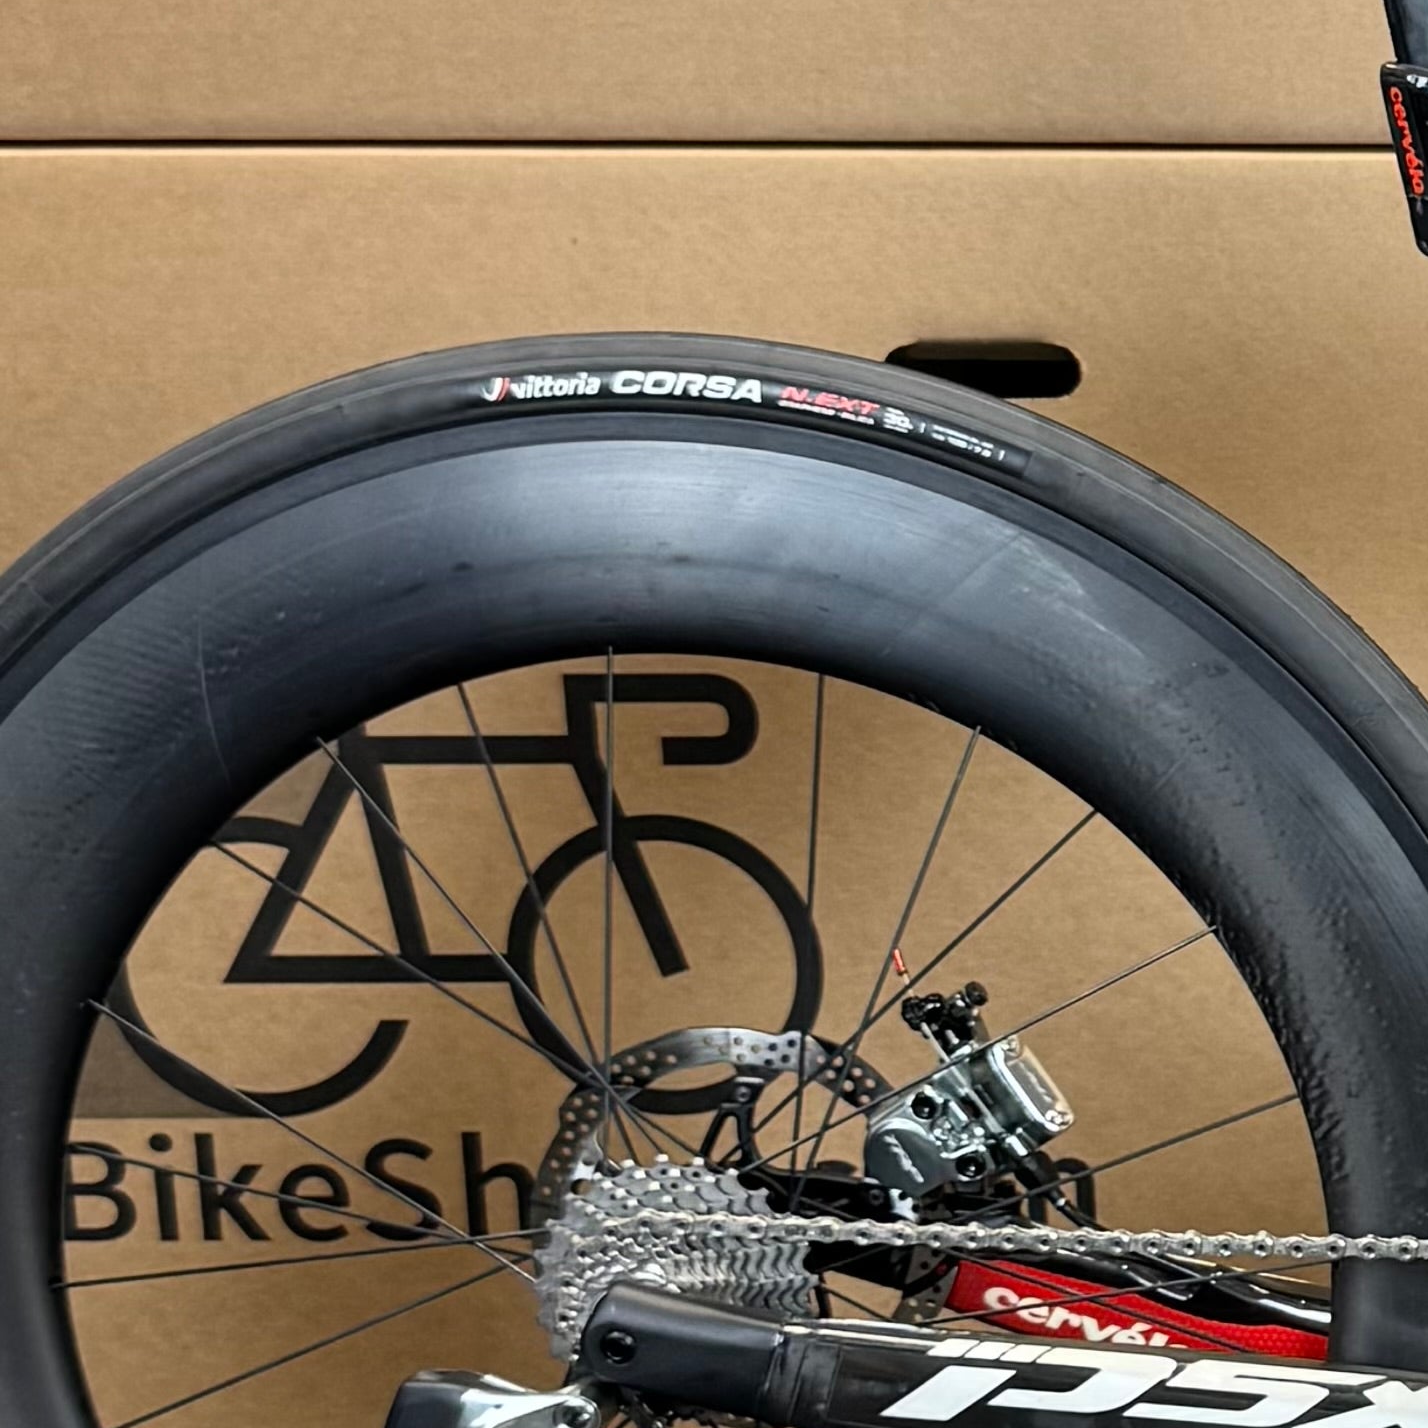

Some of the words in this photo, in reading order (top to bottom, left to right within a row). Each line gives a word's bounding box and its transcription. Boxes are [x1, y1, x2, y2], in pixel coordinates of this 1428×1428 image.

[1389, 86, 1425, 195] cervélo
[511, 372, 602, 401] vittoria
[610, 369, 764, 405] CORSA
[983, 1286, 1188, 1348] cervél
